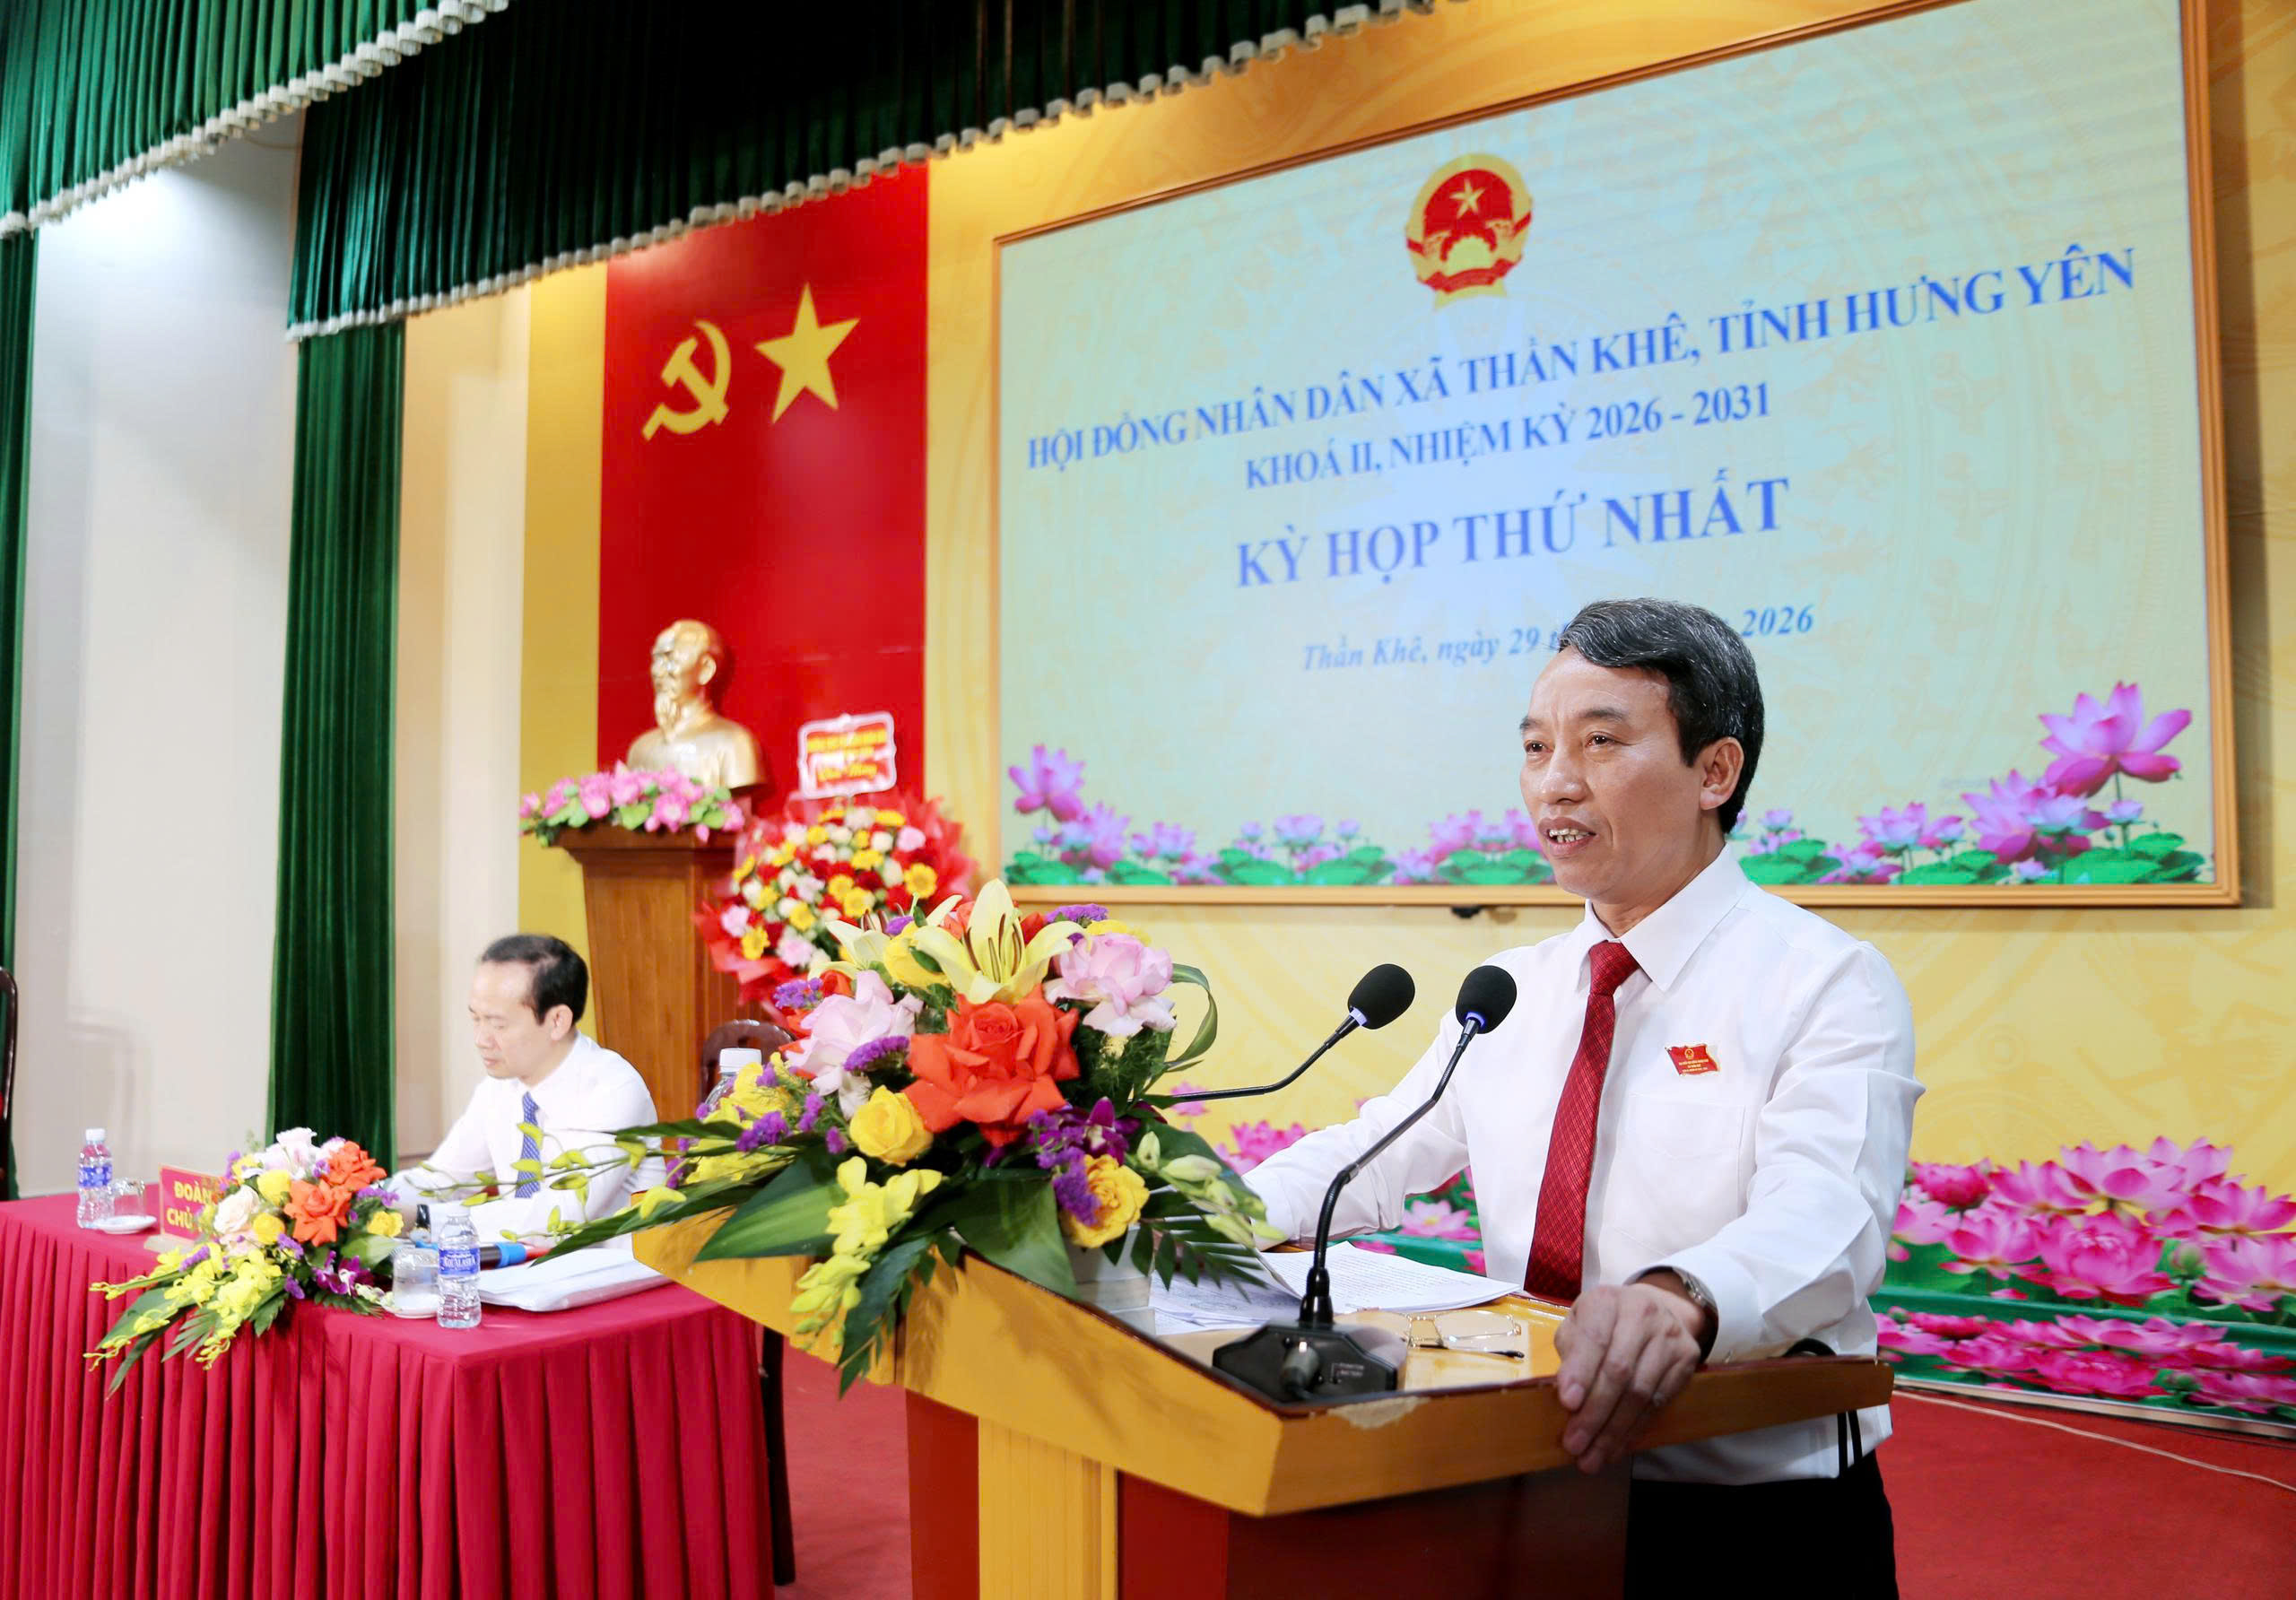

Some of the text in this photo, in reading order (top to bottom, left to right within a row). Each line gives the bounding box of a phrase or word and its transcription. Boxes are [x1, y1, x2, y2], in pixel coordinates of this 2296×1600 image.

[1091, 412, 1187, 457] ĐỒNG
[1196, 386, 1297, 440] NHÂN
[1305, 370, 1385, 422] DÂN
[1395, 356, 1450, 406] XÃ
[1592, 312, 1700, 374] KHÊ,
[1708, 299, 1831, 355] TỈNH
[1845, 271, 2005, 334] HƯNG
[2017, 243, 2136, 308] YÊN
[1246, 438, 1342, 490] KHOÁ
[1350, 441, 1382, 476] II,
[1390, 420, 1512, 470] NHIỆM
[1523, 402, 1576, 450] KỲ
[1587, 398, 1663, 441] 2026
[1692, 380, 1770, 426] 2031
[1236, 467, 1790, 588] KỲ HỌP THỨ NHẤT
[1372, 634, 1429, 667] Khê,
[1437, 630, 1500, 665] ngày
[1508, 627, 1541, 656] 29
[1740, 604, 1815, 639] 2026
